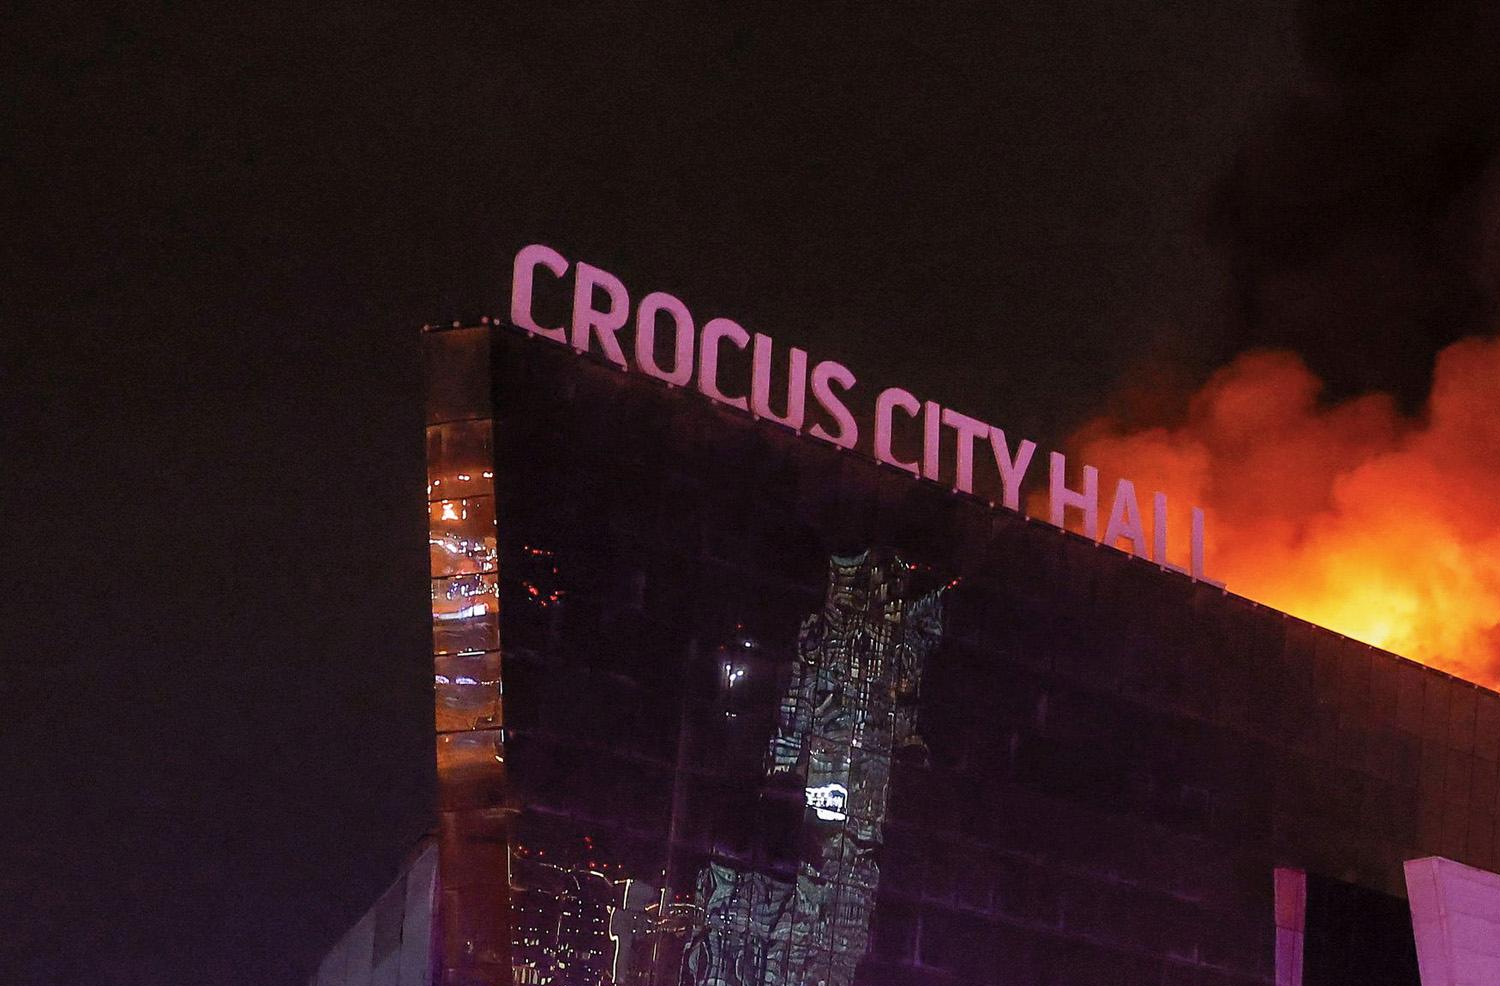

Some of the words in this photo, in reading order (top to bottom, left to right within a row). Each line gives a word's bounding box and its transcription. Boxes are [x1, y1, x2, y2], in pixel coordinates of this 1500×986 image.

[511, 244, 858, 452] CROCUS
[874, 387, 1037, 512] CITY
[1049, 452, 1227, 590] HALL
